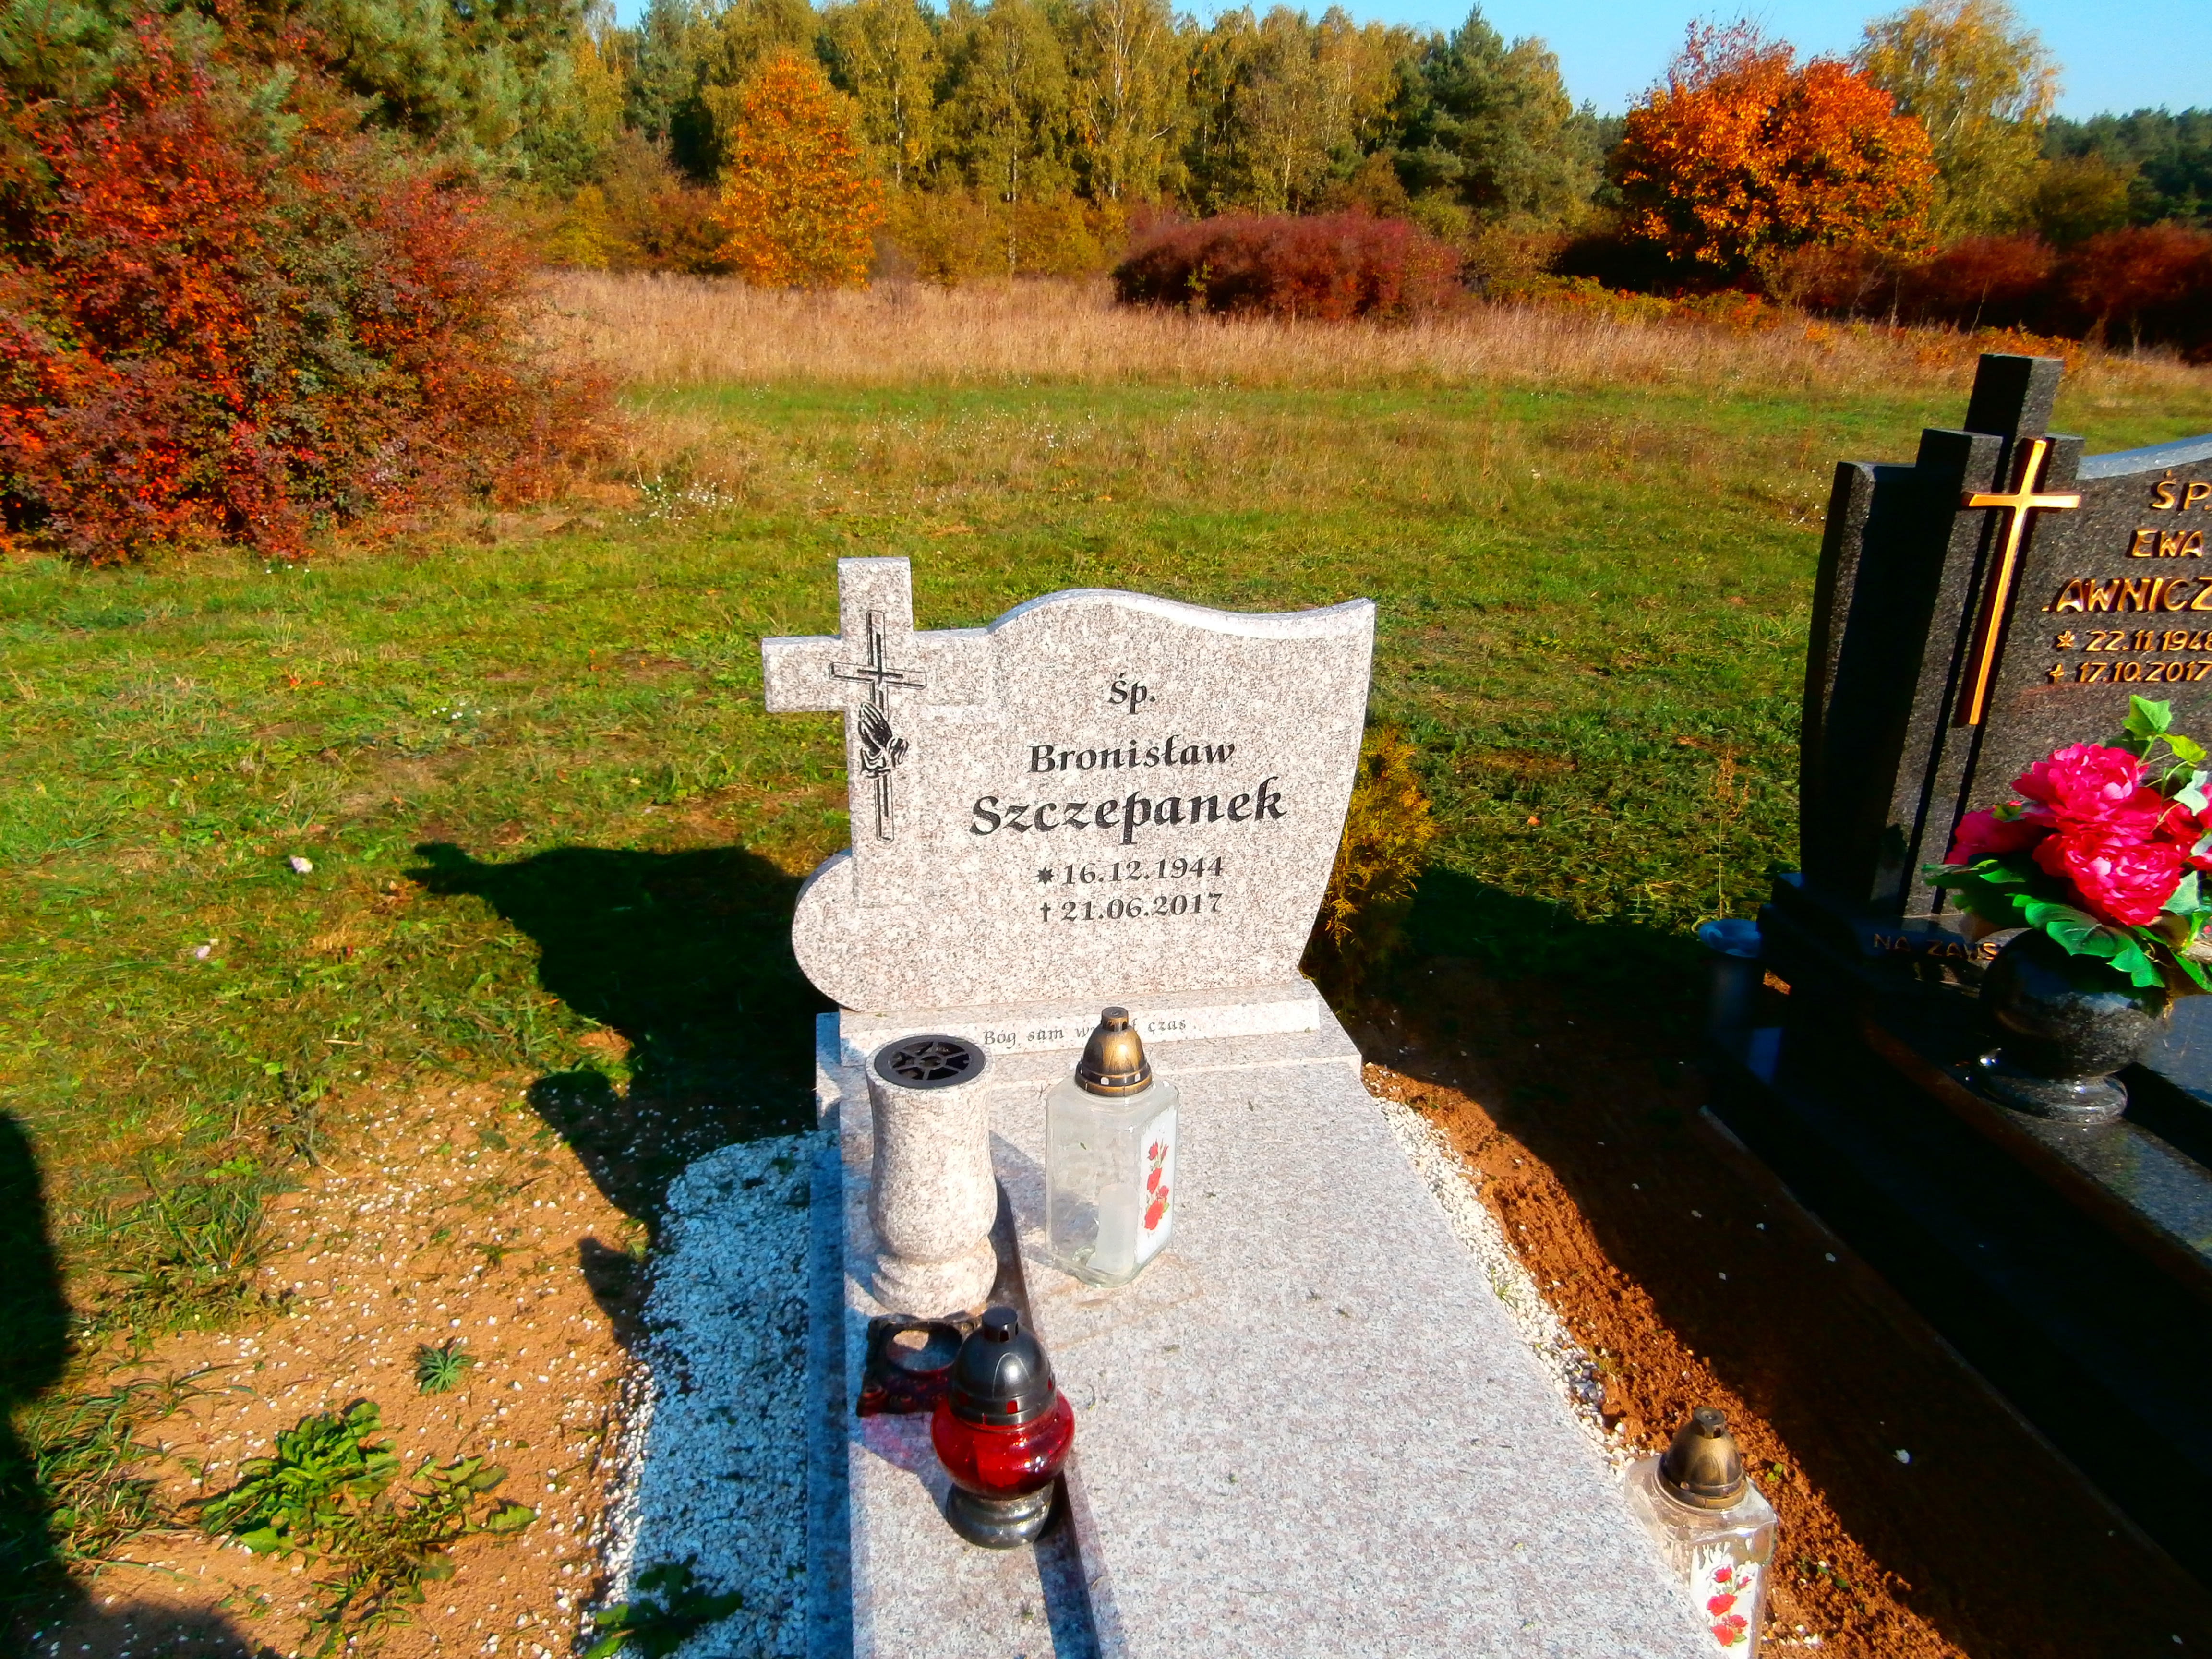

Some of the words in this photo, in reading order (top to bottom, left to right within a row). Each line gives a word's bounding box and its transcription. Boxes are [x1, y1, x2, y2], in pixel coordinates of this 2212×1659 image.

[2132, 529, 2204, 557] EWA
[2080, 661, 2212, 683] 17.10.2017
[1026, 734, 1235, 773] Bronisław
[969, 776, 1287, 846] Szczepanek
[1062, 856, 1223, 885] 16.12.1944
[1061, 892, 1223, 922] 21.06.2017
[1874, 933, 1911, 952] NA
[984, 1029, 1016, 1049] Bóg
[1028, 1029, 1064, 1042] sam
